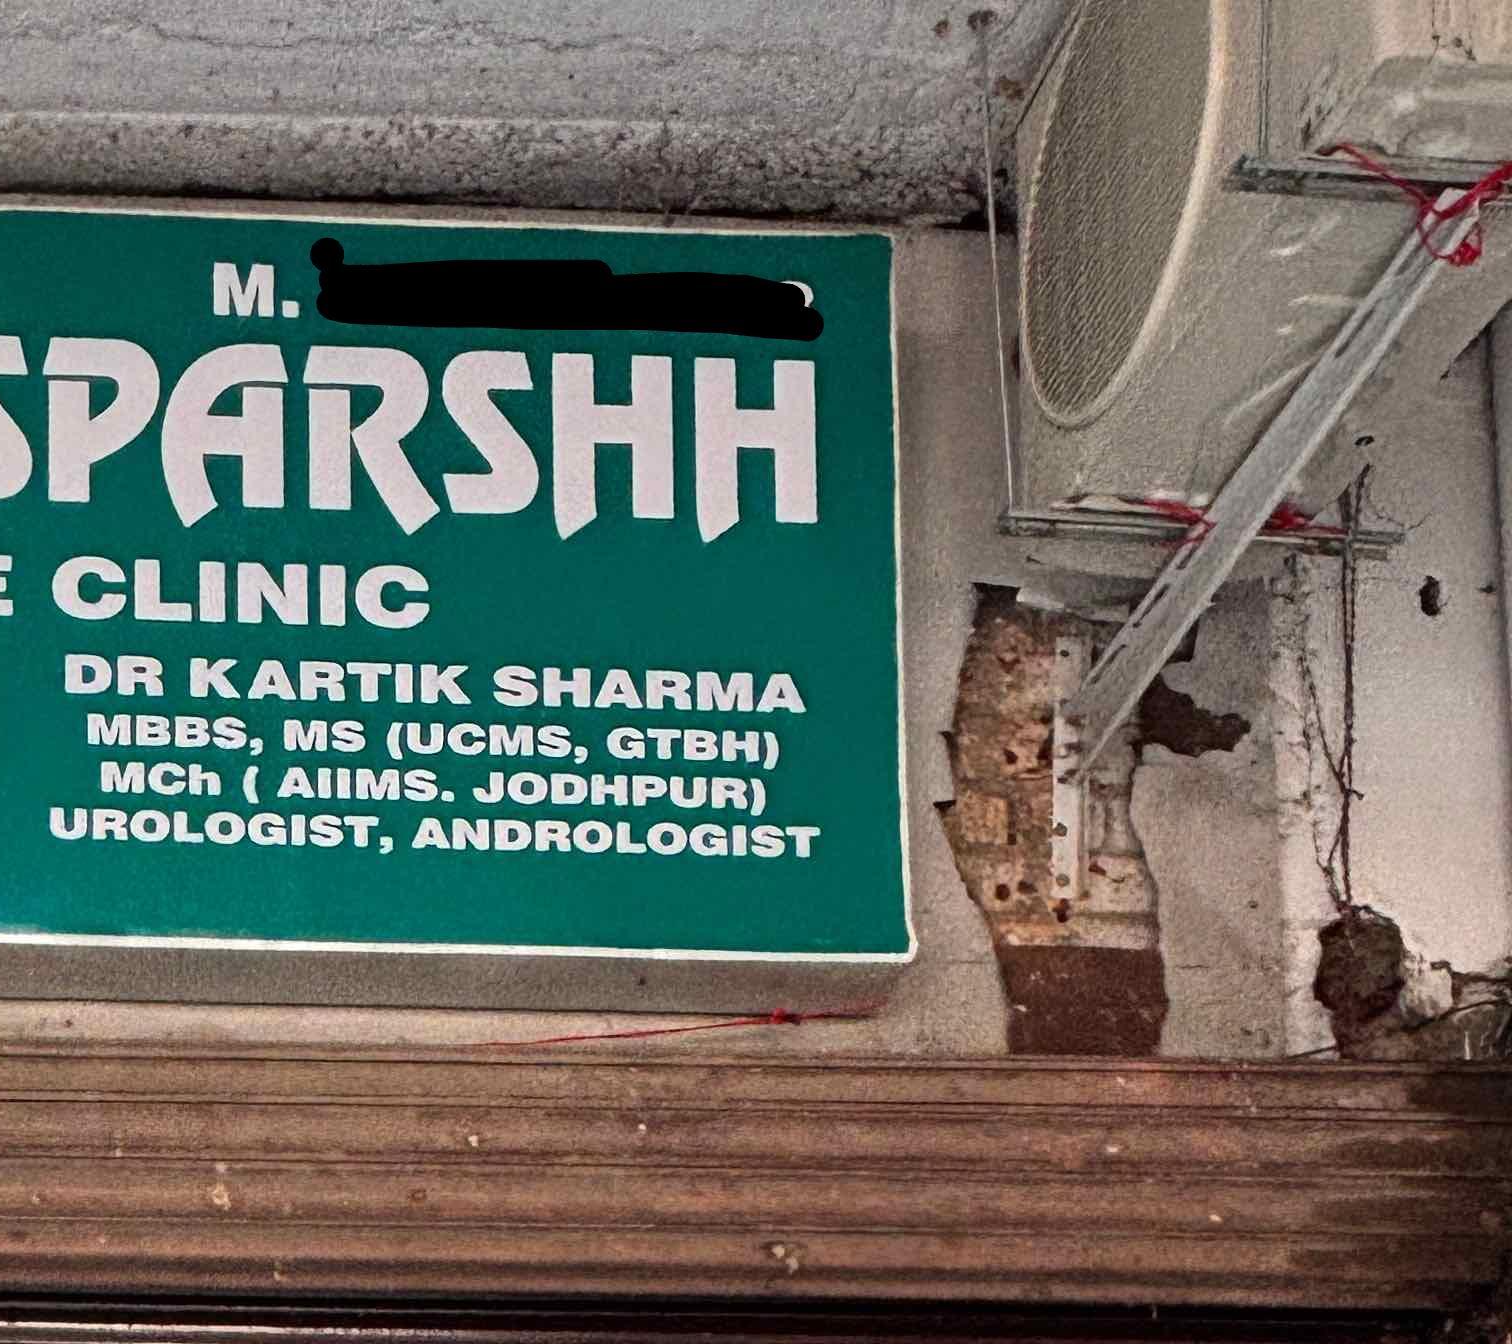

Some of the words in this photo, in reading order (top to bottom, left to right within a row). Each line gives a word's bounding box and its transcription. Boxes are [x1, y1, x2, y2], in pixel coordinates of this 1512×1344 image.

[212, 262, 300, 318] M.
[51, 555, 430, 629] CLINIC
[64, 653, 164, 697] DR
[189, 657, 472, 705] KARTIK
[493, 665, 806, 714] SHARMA
[87, 713, 264, 756] MBBS,
[283, 719, 366, 753] MS
[386, 722, 589, 764] (UCMS,
[606, 727, 780, 770] GTBH)
[100, 761, 221, 796] MCh
[277, 766, 455, 802] AIIMS.
[472, 771, 766, 817] JODHPUR)
[49, 807, 394, 854] UROLOGIST,
[411, 817, 821, 858] ANDROLOGIST
